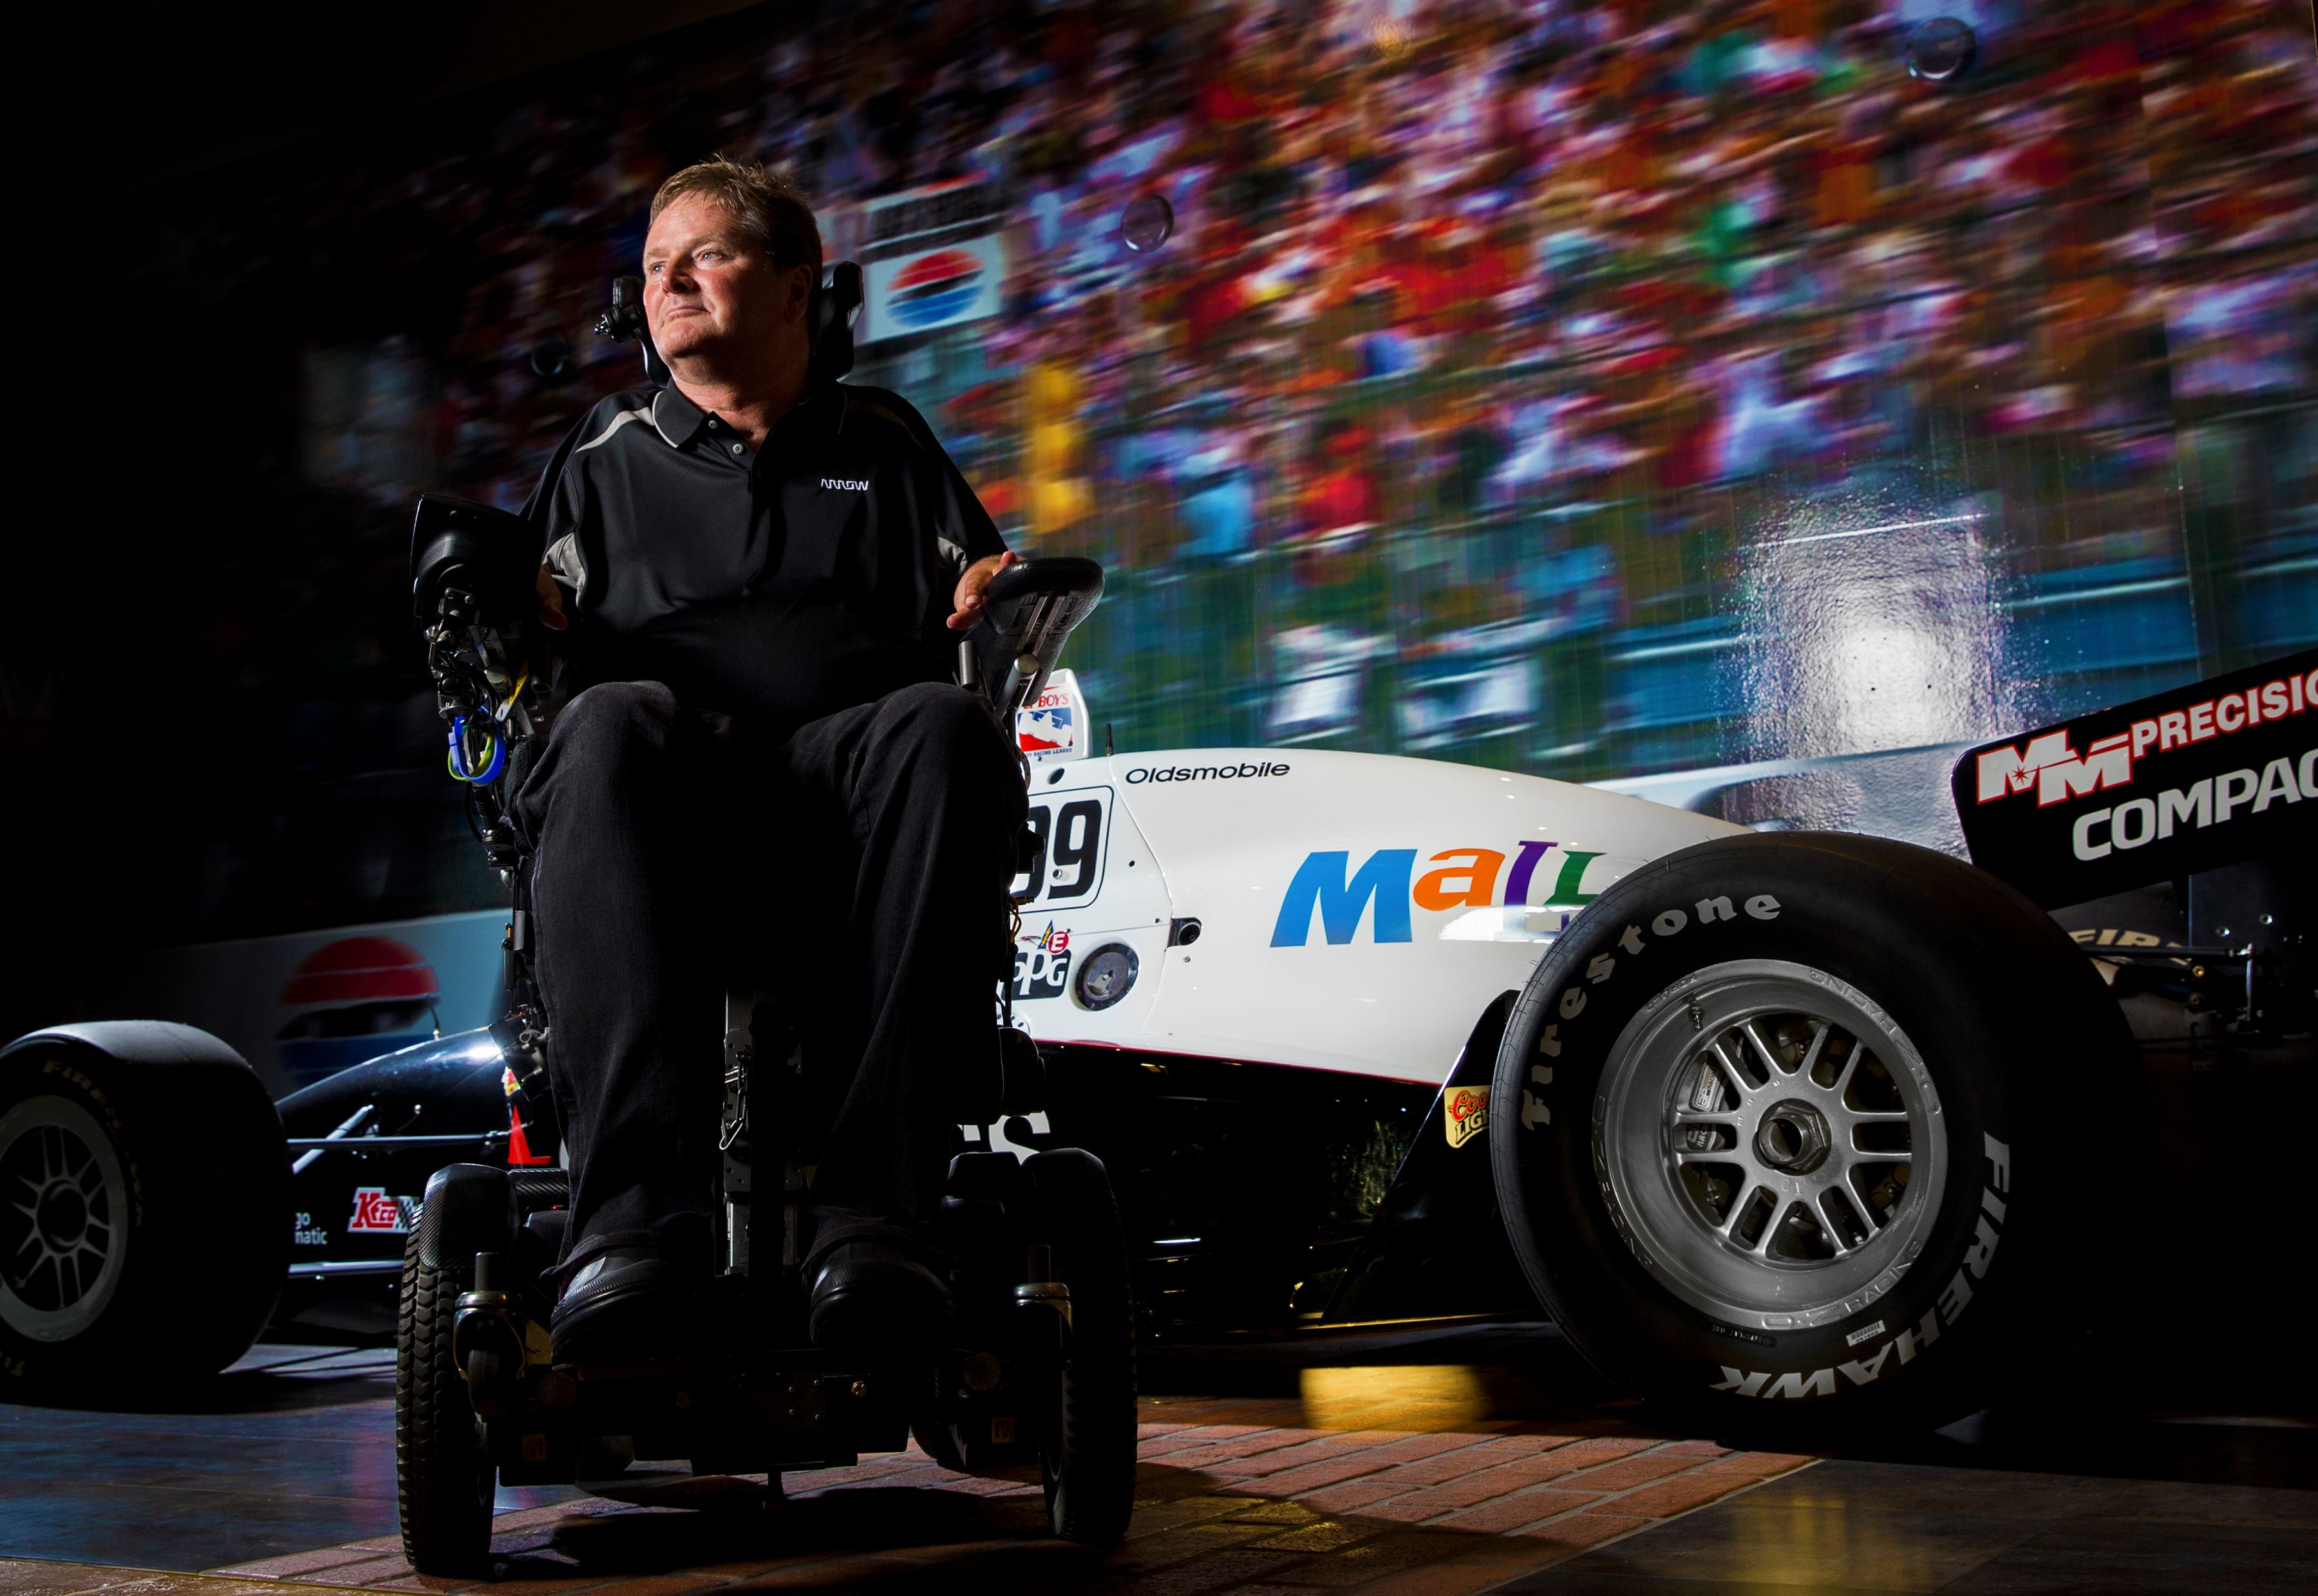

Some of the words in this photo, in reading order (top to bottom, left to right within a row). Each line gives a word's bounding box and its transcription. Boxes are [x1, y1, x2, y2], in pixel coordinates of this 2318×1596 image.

[820, 478, 869, 491] ARROW
[1038, 694, 1069, 708] BOYS
[1125, 762, 1290, 784] Oldsmobile
[1521, 894, 1781, 1131] Firestone
[1447, 1089, 1491, 1122] Coo
[1455, 1109, 1491, 1145] LIGH
[1708, 1131, 2010, 1399] FIREHAWK
